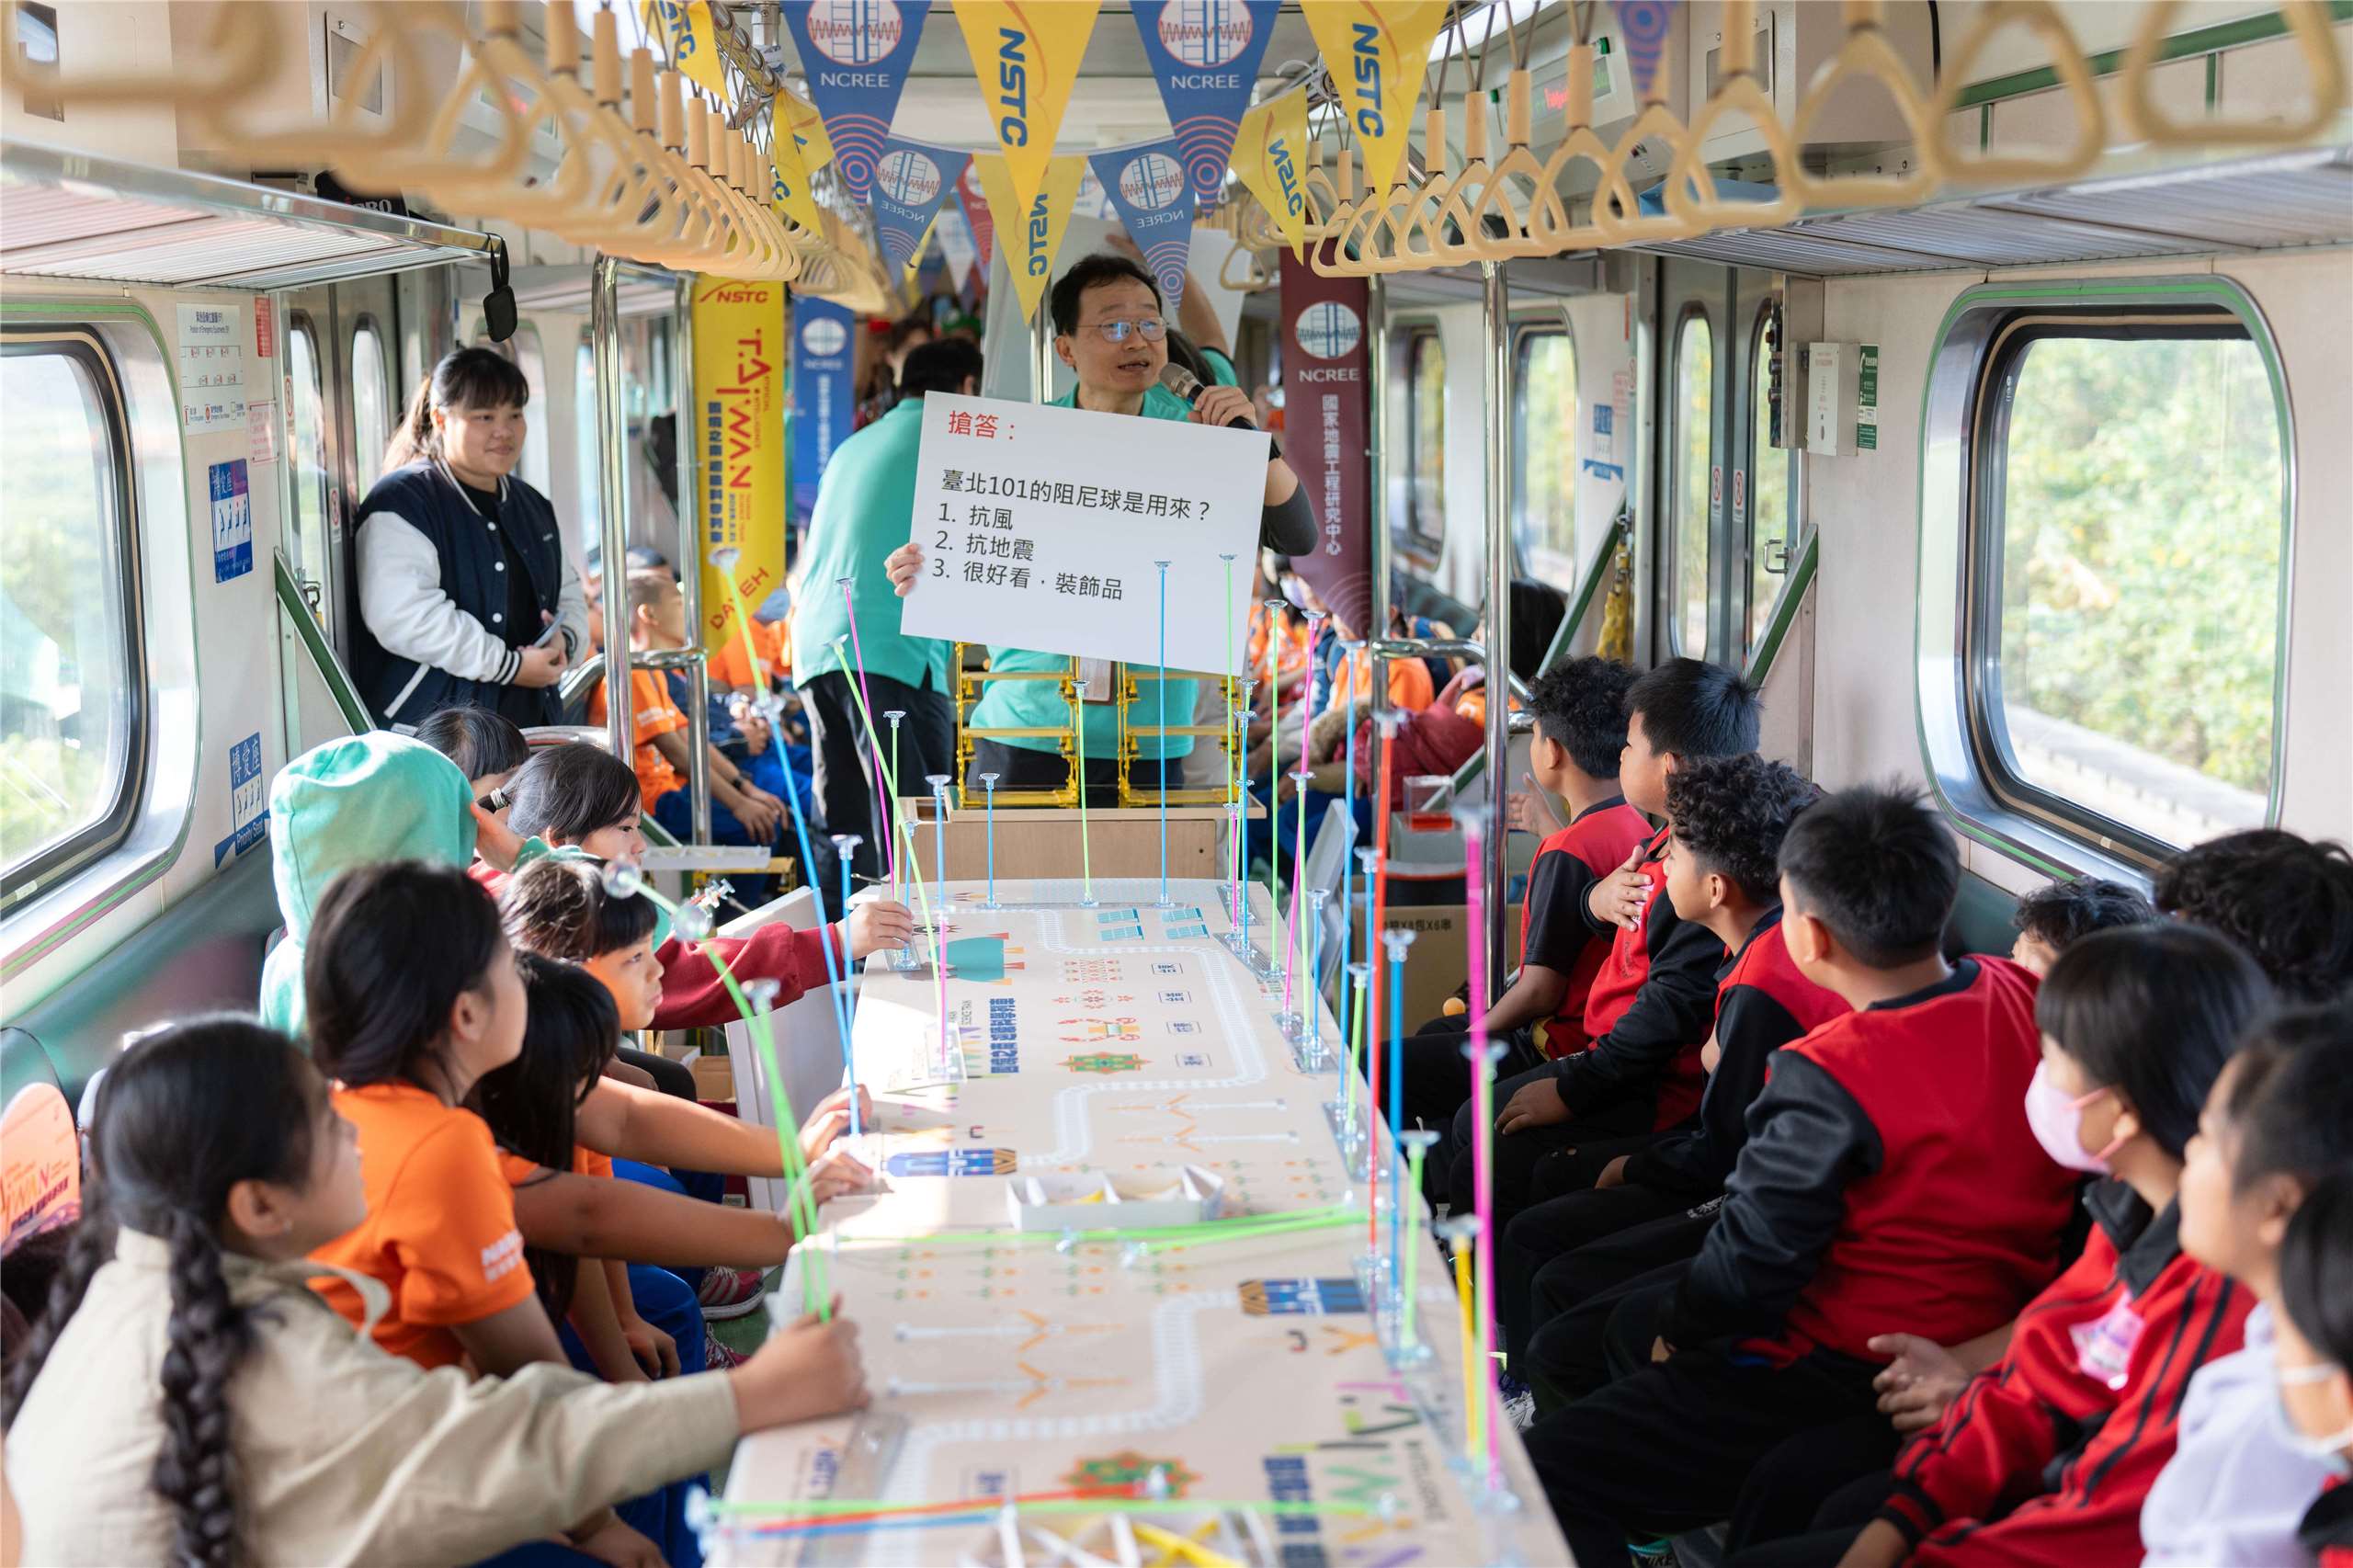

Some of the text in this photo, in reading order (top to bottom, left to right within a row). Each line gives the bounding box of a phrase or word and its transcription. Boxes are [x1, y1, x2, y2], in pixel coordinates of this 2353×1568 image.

[821, 74, 890, 88] NCREE
[999, 28, 1028, 147] NSTC
[1171, 74, 1240, 89] NCREE
[1352, 24, 1383, 138] NSTC
[717, 290, 768, 303] NSTC
[1299, 369, 1360, 382] NCREE
[948, 410, 1016, 440] 搶答：
[1322, 394, 1341, 556] 國家地震工程研究中心
[942, 469, 1211, 521] 臺北101的阻尼球是用來？
[938, 503, 1013, 530] 1. 抗風
[935, 530, 1035, 562] 2. 抗地震
[932, 558, 950, 579] 3.
[710, 566, 770, 631] DAEH
